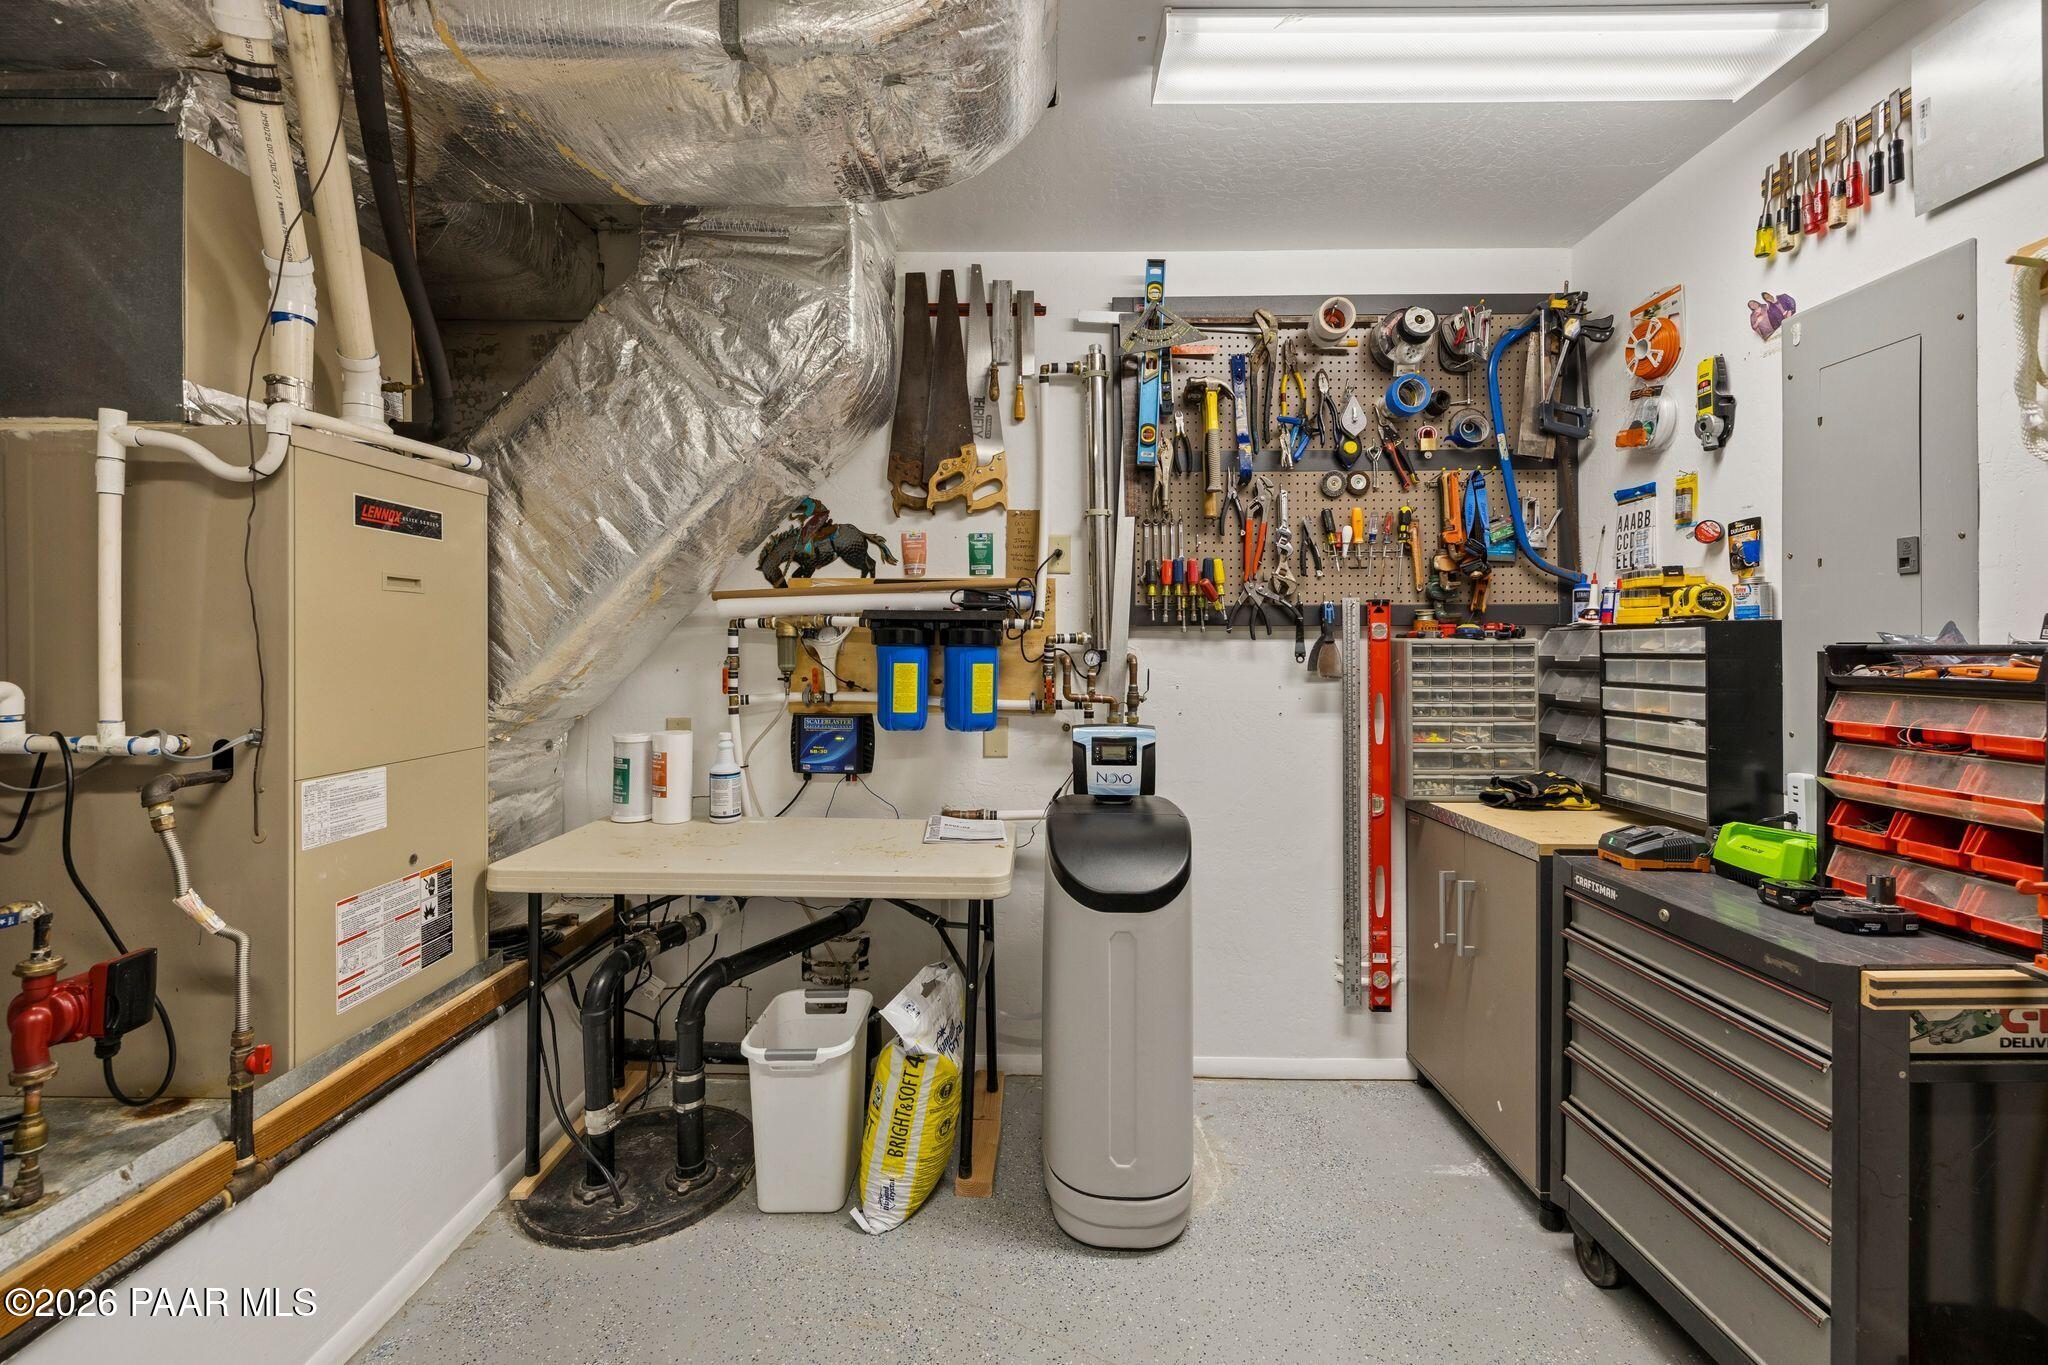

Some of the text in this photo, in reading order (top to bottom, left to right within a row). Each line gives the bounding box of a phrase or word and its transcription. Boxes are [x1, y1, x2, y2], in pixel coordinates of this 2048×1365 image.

[361, 503, 403, 524] LENNOX
[1616, 509, 1651, 533] AAABB
[1097, 771, 1133, 784] NOVO
[1575, 875, 1616, 900] CRAFTSMAN
[2000, 1037, 2048, 1048] DELIV
